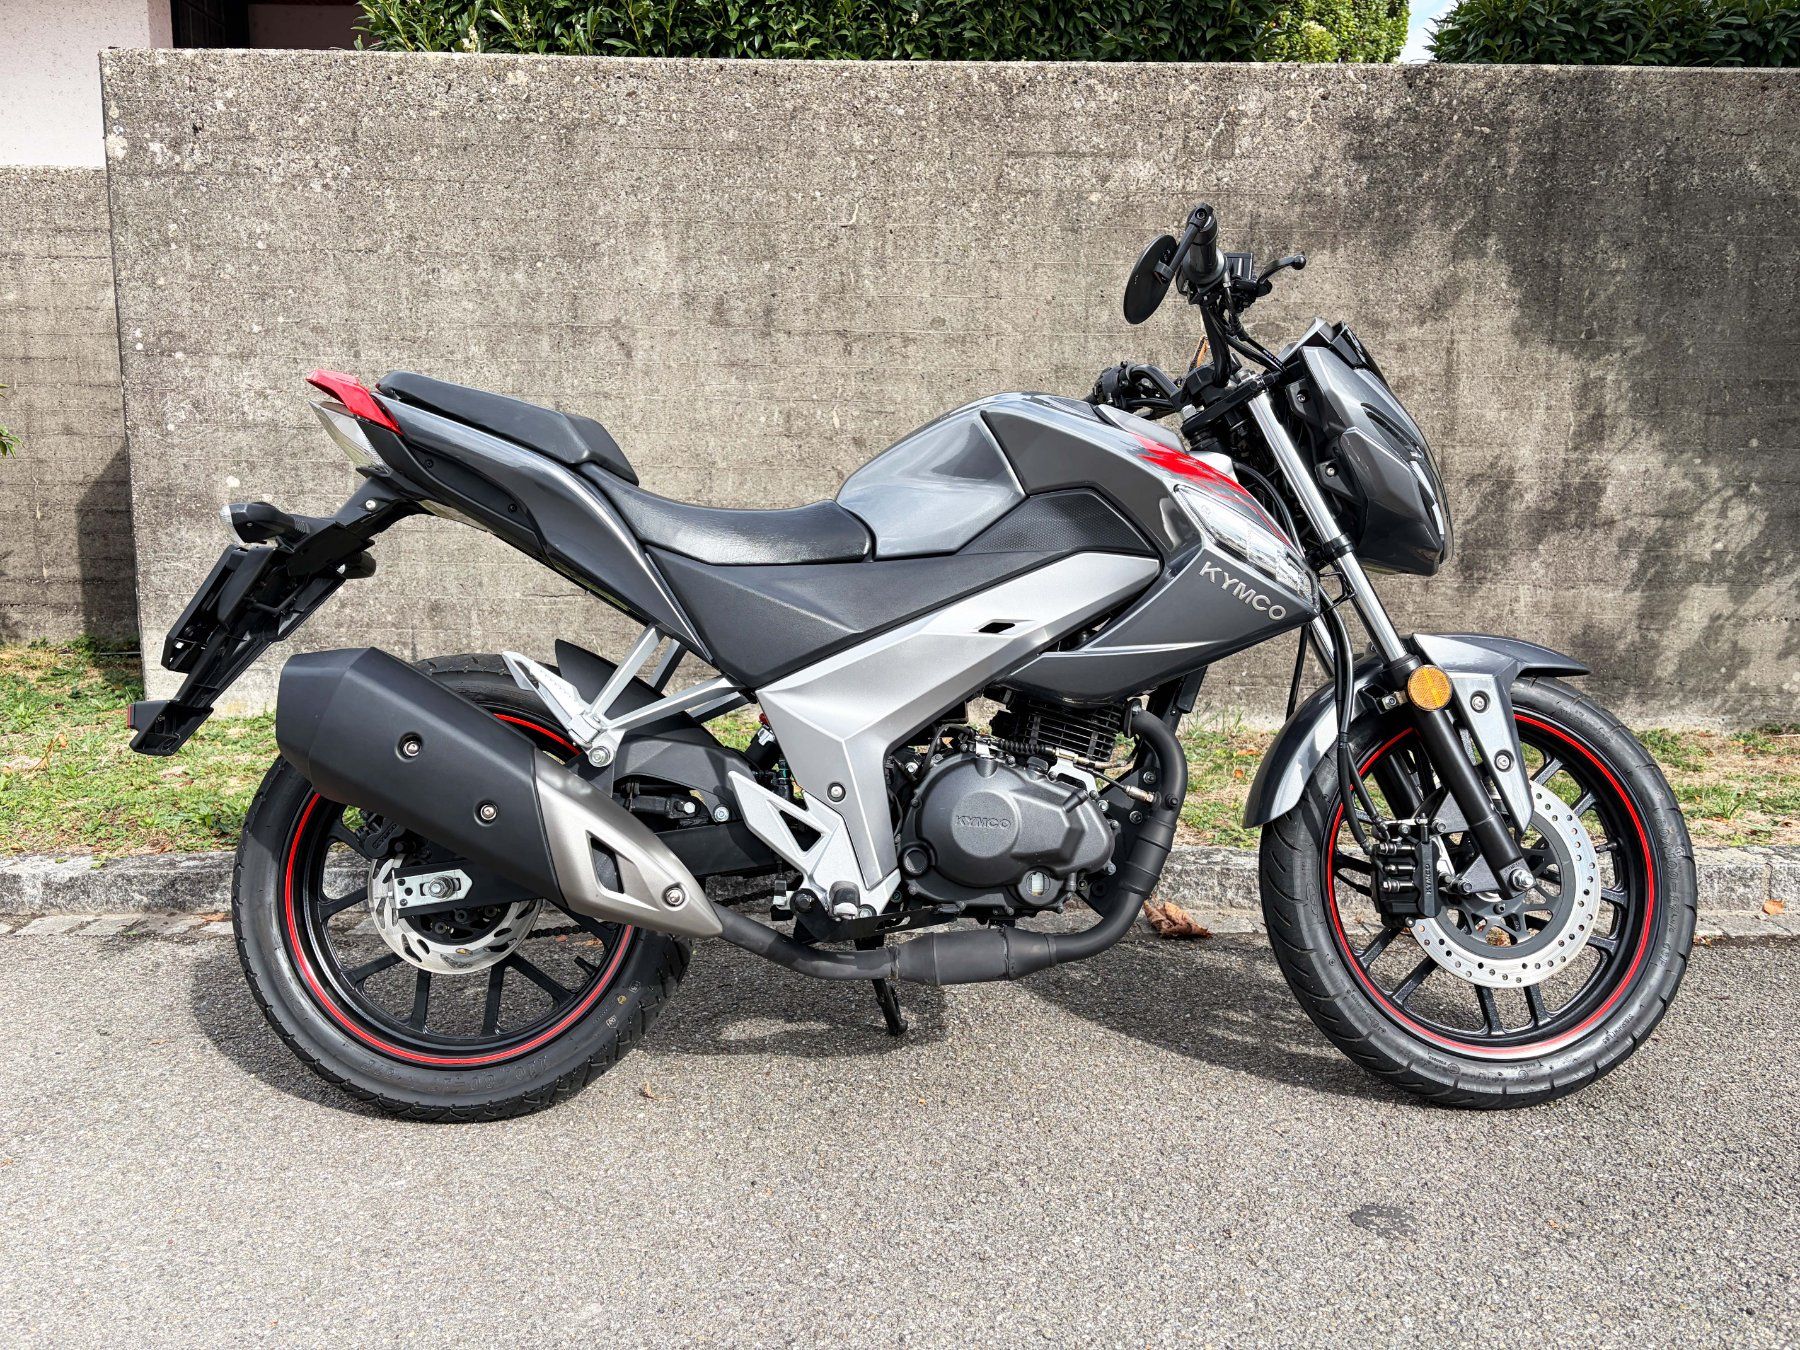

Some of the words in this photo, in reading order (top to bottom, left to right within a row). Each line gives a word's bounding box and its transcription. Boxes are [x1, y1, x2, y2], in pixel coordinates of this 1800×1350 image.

[1199, 561, 1287, 621] KYMCO
[955, 815, 1011, 829] KYMCO
[1424, 863, 1433, 895] KYMCO
